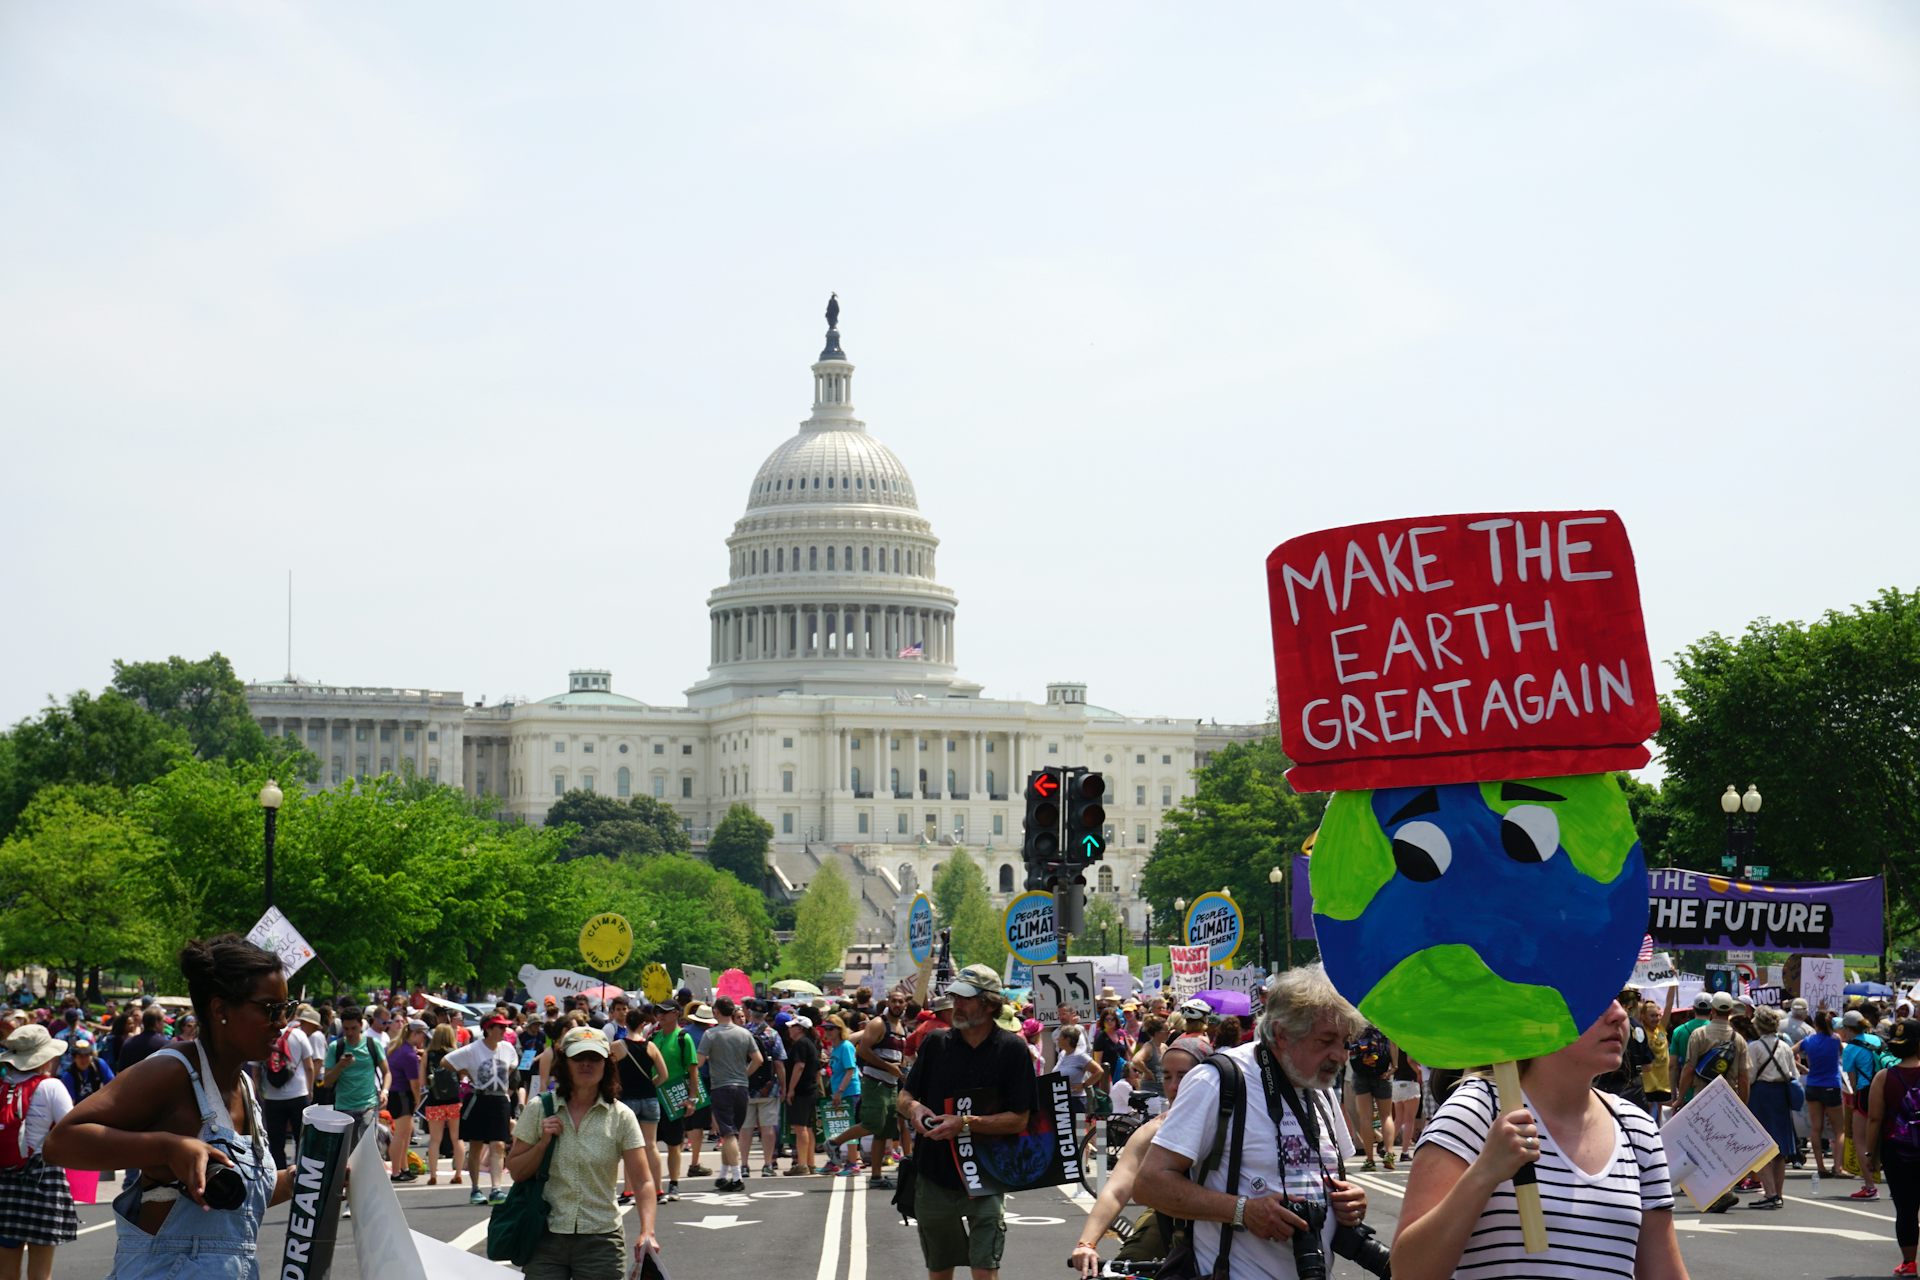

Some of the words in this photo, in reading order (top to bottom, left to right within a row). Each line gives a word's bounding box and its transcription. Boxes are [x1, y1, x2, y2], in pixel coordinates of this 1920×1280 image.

[1282, 525, 1454, 626] MAKE
[1467, 517, 1613, 586] THE
[1330, 599, 1558, 684] EARTH
[1302, 679, 1471, 750] GREAT
[1481, 658, 1634, 731] AGAIN
[1649, 870, 1697, 891] THE
[587, 917, 626, 938] CLIMATE
[1008, 916, 1053, 942] CLIMAT
[1190, 914, 1237, 943] CLIMATE
[1704, 900, 1827, 933] FUTURE
[586, 948, 625, 968] JUSTICE
[1171, 946, 1208, 961] NASTY
[1811, 961, 1833, 974] WE
[1804, 982, 1838, 997] PARIS
[1264, 1066, 1275, 1096] DIGITAL
[828, 1120, 850, 1128] RISE
[1052, 1081, 1076, 1157] CLIMATE
[962, 1161, 982, 1190] NO
[1062, 1160, 1080, 1180] IN
[282, 1155, 326, 1280] DREAM
